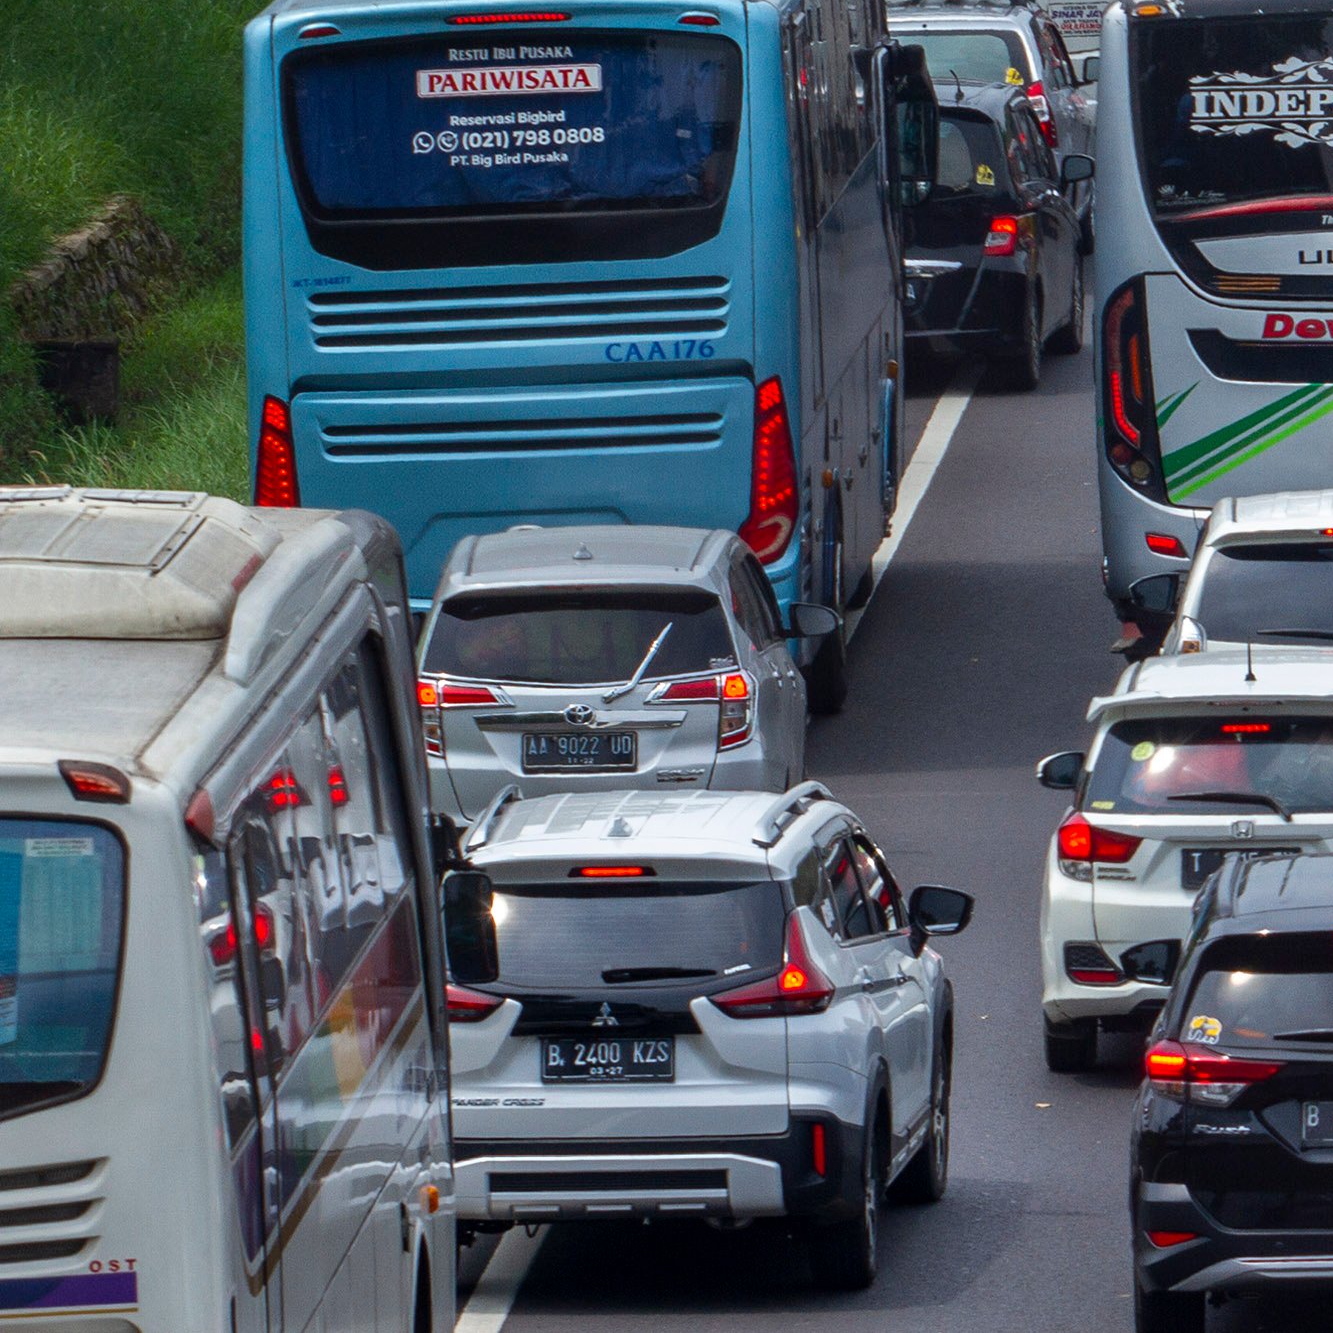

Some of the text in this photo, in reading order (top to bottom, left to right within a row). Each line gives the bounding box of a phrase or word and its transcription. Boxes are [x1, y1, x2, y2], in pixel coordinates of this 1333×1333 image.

[448, 45, 574, 62] RESTU IBU PUSAKA
[427, 68, 593, 93] PARIWISATA
[450, 110, 566, 127] Reservasi Bigbird
[462, 126, 606, 150] (021) 798 0808
[450, 151, 569, 168] PT. Big Bird Pusaka
[673, 339, 715, 360] 176
[528, 735, 632, 755] AA 9022 UD
[548, 1041, 670, 1066] B 2400 KZS
[589, 1066, 623, 1076] 03-27
[1306, 1104, 1320, 1128] B
